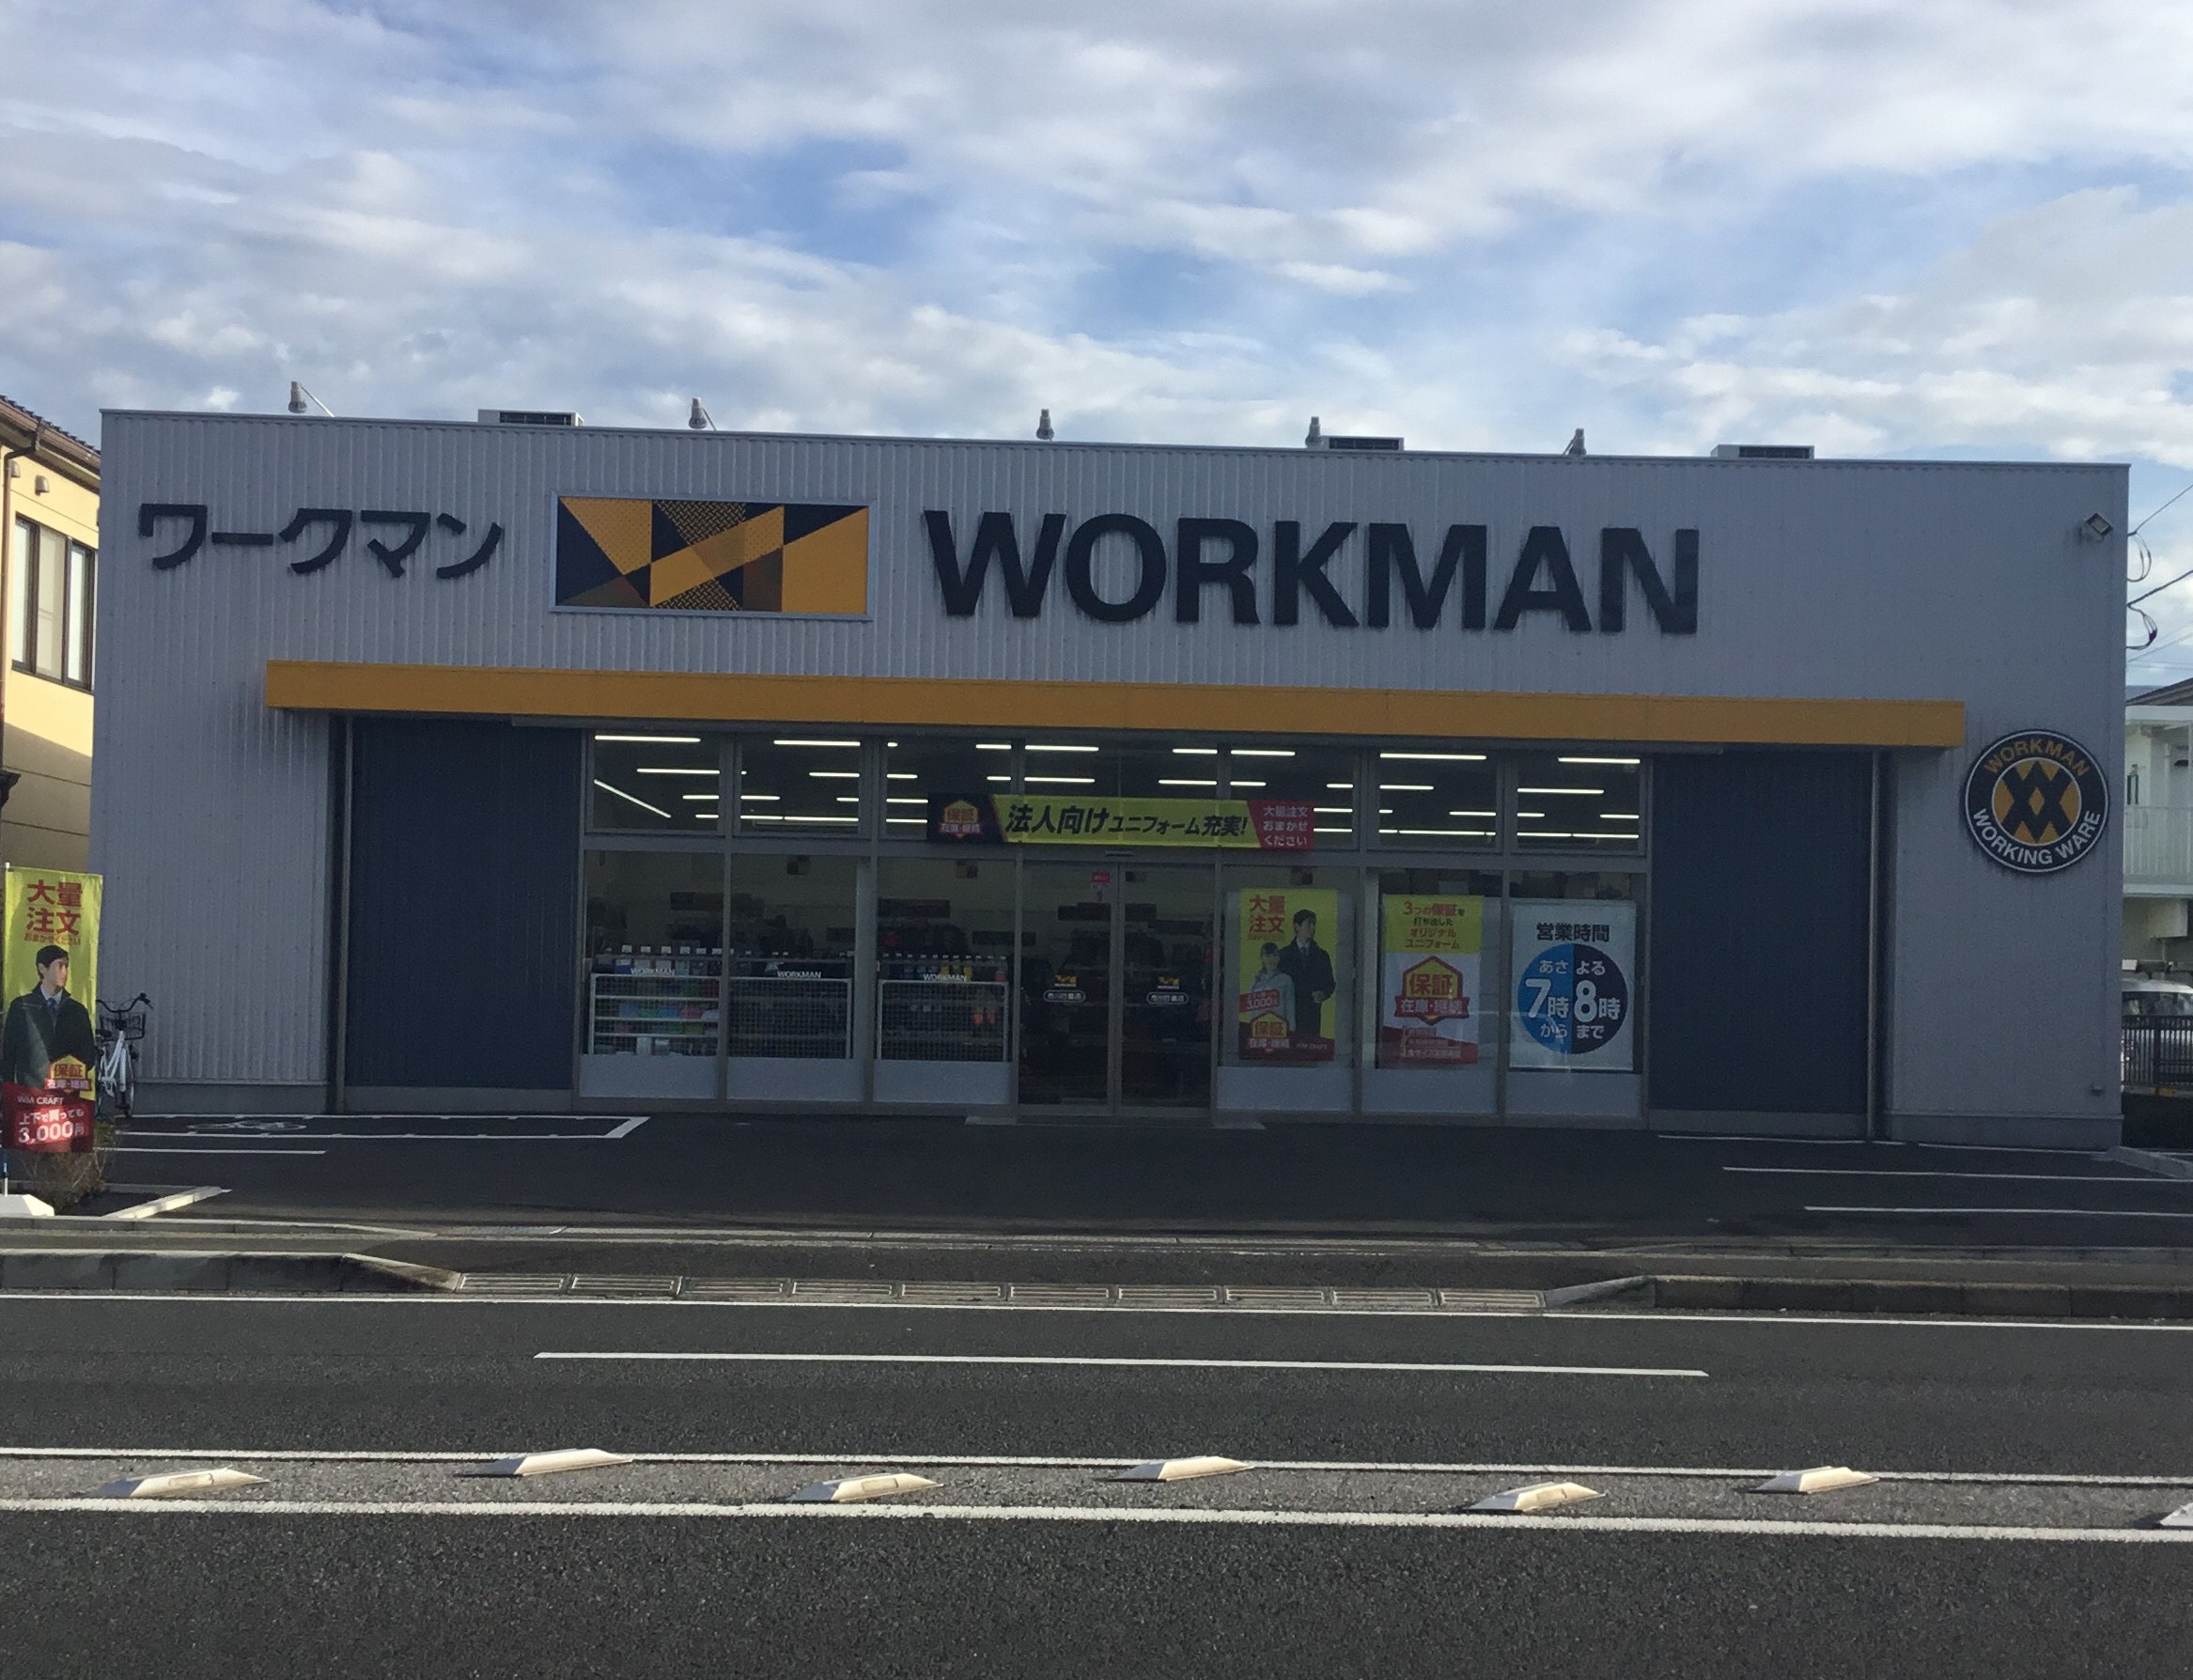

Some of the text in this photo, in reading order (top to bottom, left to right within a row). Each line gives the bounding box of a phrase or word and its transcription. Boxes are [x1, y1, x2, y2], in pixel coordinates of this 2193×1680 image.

[139, 503, 503, 579] ワークマン
[924, 509, 1699, 634] WORKMAN
[1984, 738, 2090, 776] WORKMAN
[1264, 834, 1308, 847] ください
[1973, 808, 2101, 864] WORKING WARE
[27, 879, 83, 908] 大量
[26, 906, 82, 936] 注文
[1249, 915, 1285, 934] 注文
[1536, 922, 1610, 942] 営業時間
[777, 971, 822, 979] WORKMAN
[923, 973, 968, 982] WORKMAN
[1539, 959, 1606, 975] あさ よる
[1409, 973, 1453, 996] 保証
[1525, 978, 1621, 1022] 7時 8時
[1540, 1023, 1605, 1039] から まで
[36, 1096, 65, 1105] CRAFT
